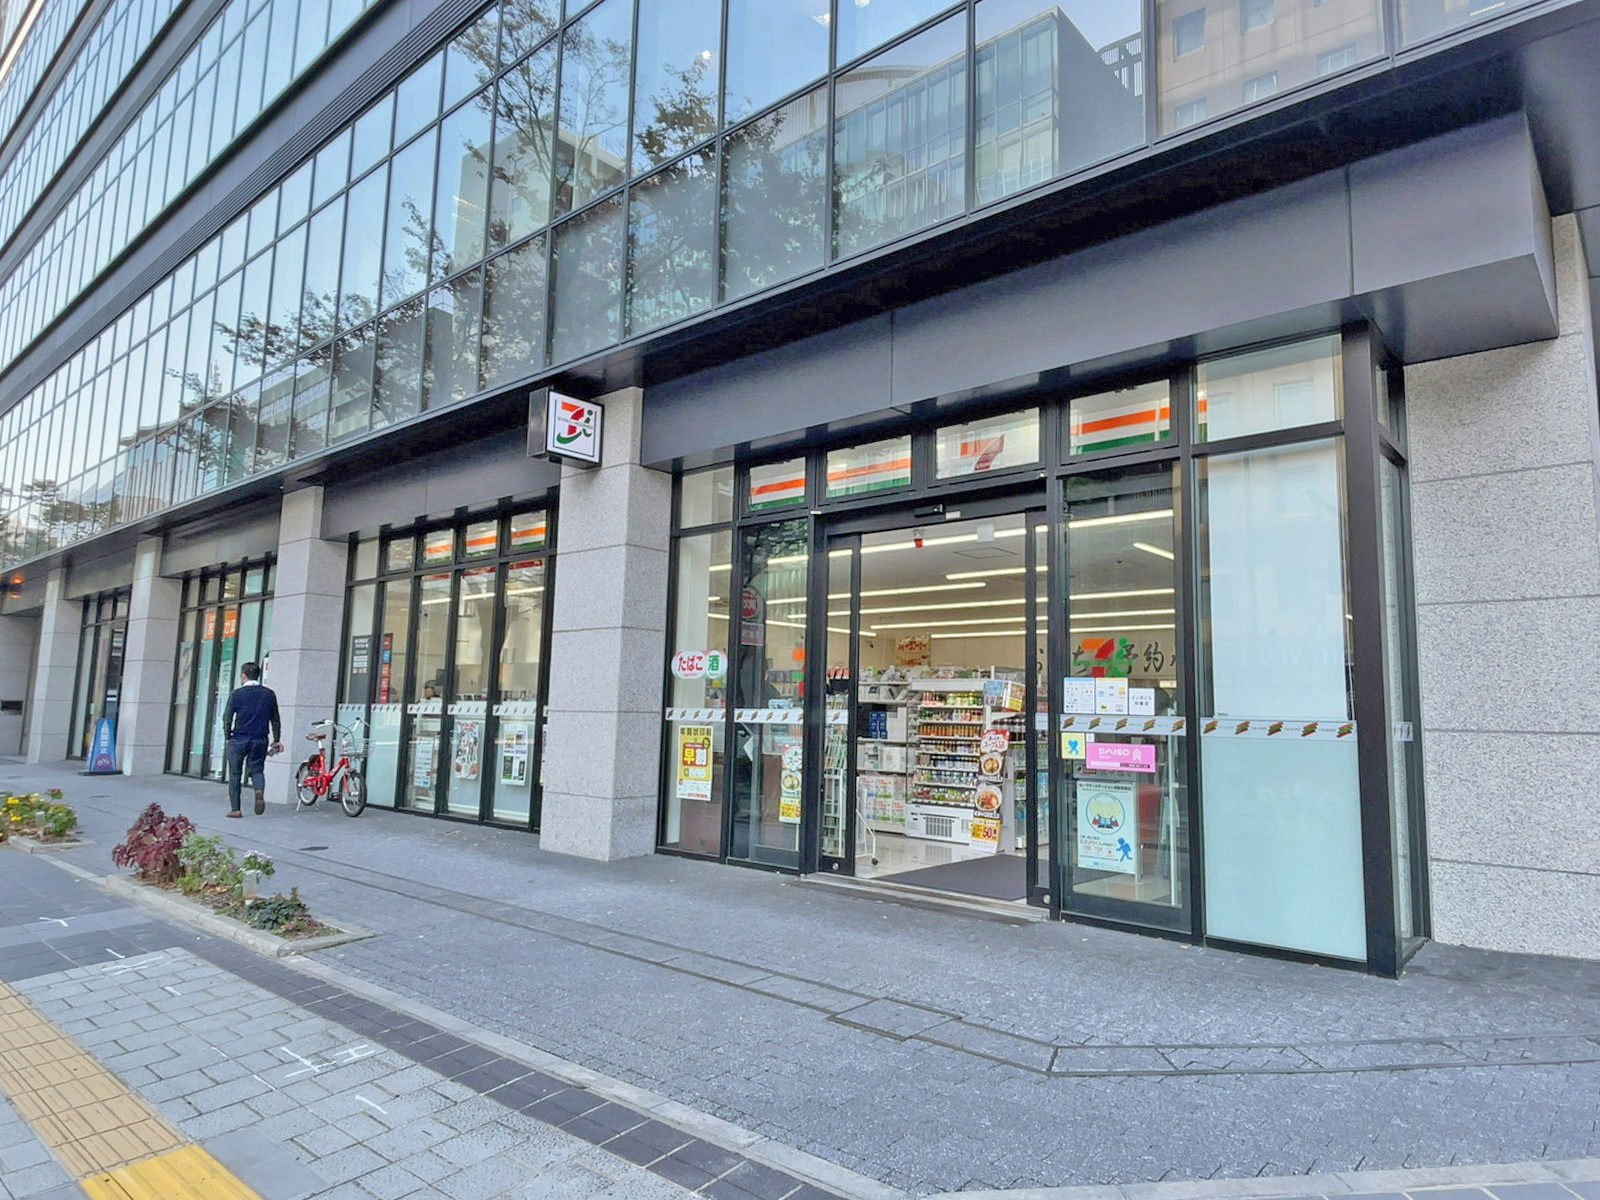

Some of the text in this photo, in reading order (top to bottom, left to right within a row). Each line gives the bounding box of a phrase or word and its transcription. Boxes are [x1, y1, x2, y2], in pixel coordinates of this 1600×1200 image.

[678, 655, 703, 671] たばこ
[708, 655, 720, 671] 酒
[1098, 748, 1130, 757] DAISO
